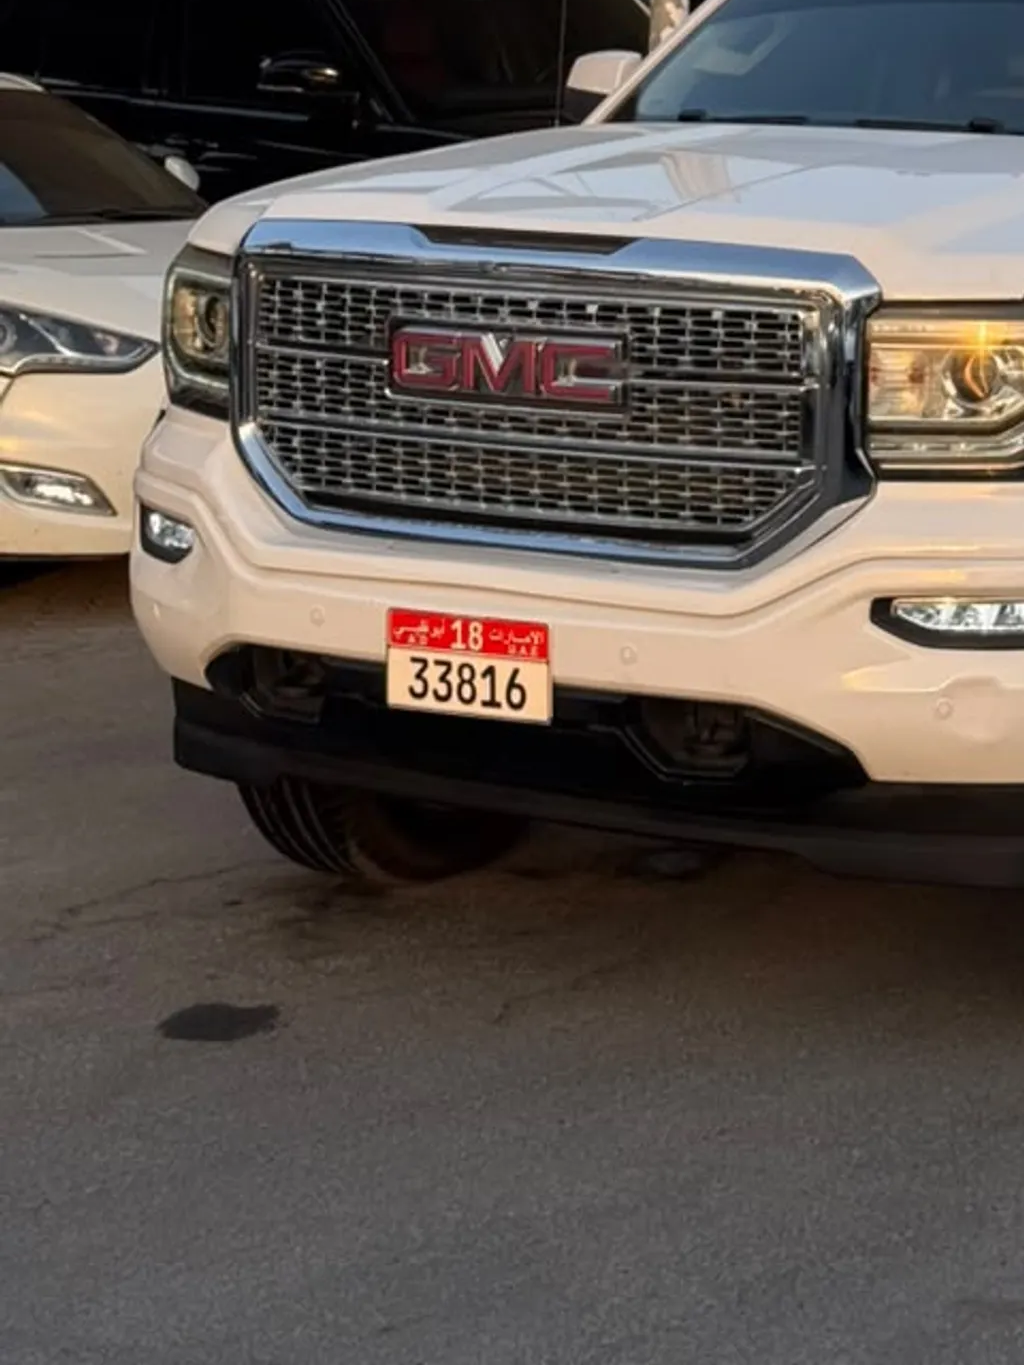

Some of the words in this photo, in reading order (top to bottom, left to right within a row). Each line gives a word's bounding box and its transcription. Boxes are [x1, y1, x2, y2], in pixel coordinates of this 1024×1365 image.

[392, 327, 623, 404] GMC
[450, 620, 484, 651] 18
[407, 655, 527, 711] 33816
